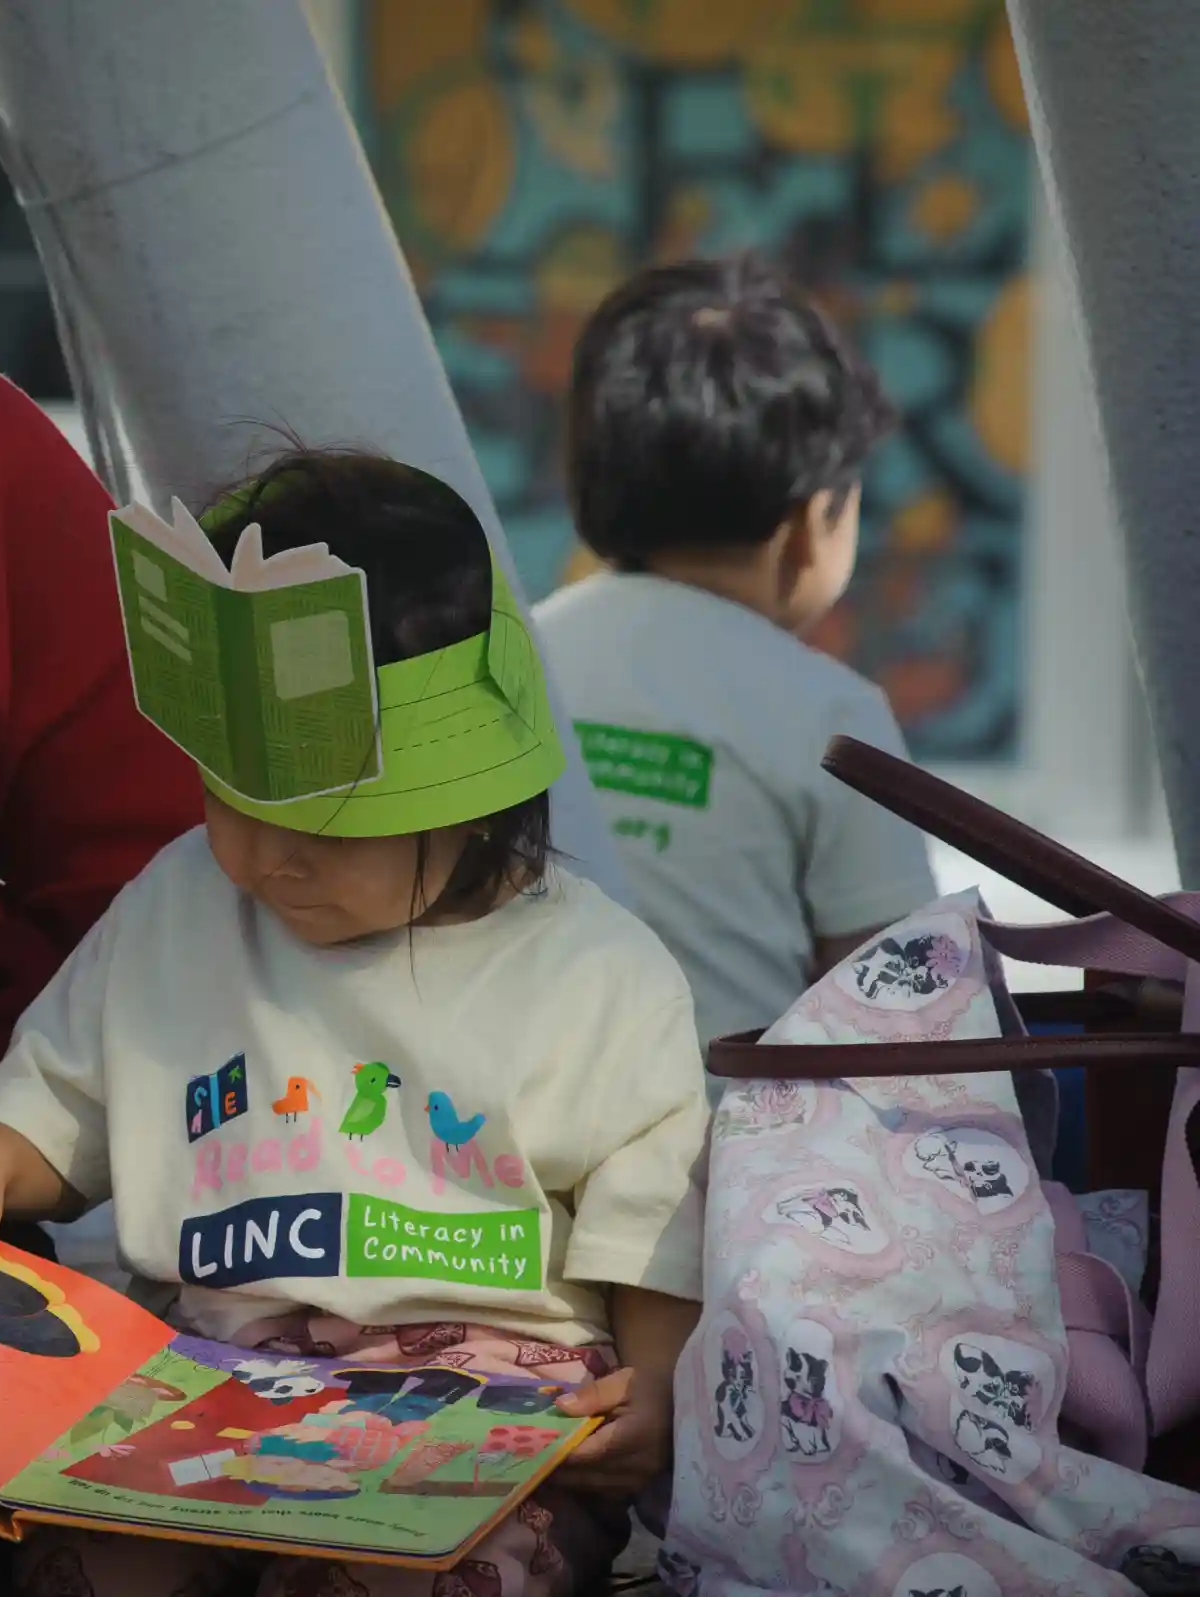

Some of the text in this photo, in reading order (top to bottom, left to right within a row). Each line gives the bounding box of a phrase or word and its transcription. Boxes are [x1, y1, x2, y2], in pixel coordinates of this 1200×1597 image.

[193, 1117, 323, 1199] Read
[430, 1138, 525, 1196] Me
[192, 1208, 326, 1278] LINC
[363, 1205, 526, 1248] Literacy in
[363, 1238, 527, 1280] Community
